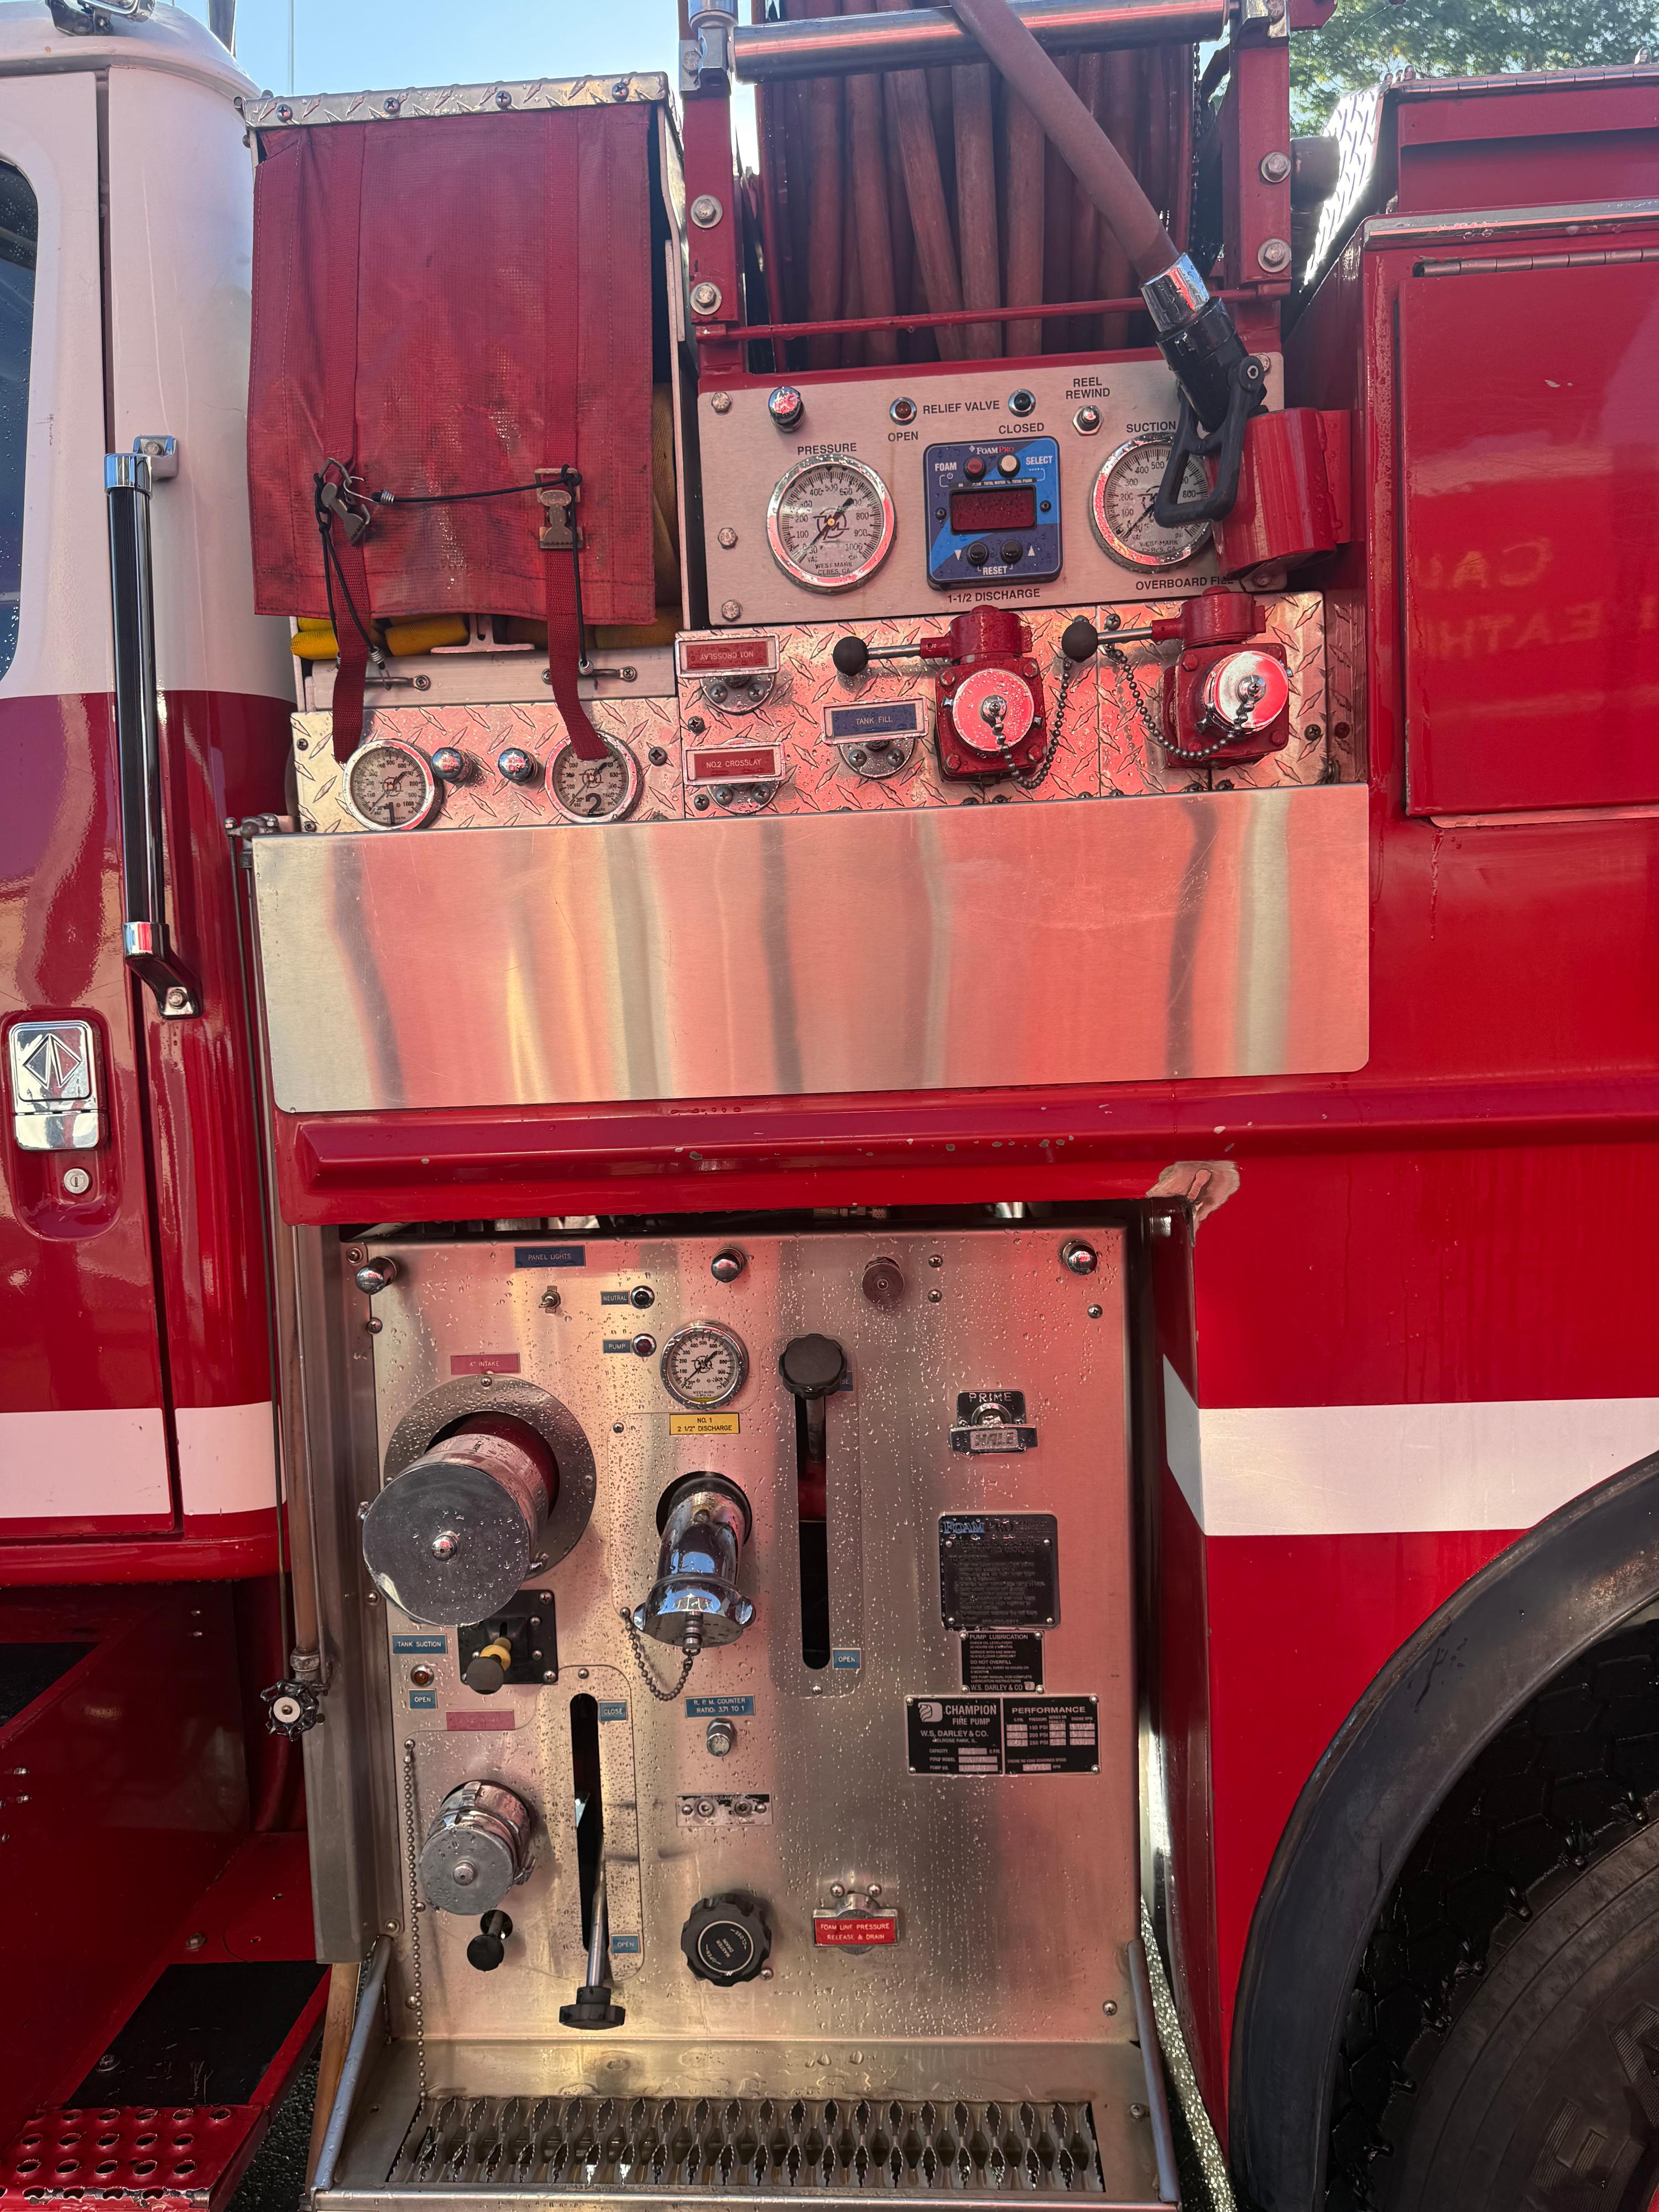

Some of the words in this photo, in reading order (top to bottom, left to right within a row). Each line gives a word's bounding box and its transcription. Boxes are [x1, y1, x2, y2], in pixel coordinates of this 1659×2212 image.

[1073, 377, 1102, 388] REEL
[1066, 388, 1110, 399] REWIND
[923, 403, 962, 414] RELIEF
[964, 400, 1000, 411] VALVE
[999, 422, 1045, 434] CLOSED
[1126, 421, 1176, 433] SUCTION
[888, 431, 919, 441] OPEN
[797, 442, 857, 455] PRESSURE
[1026, 455, 1053, 466] SELECT
[1151, 461, 1165, 469] 500
[935, 462, 957, 472] FOAM
[1121, 509, 1134, 517] 100
[983, 566, 1008, 575] RESET
[1136, 577, 1207, 590] OVERBOARD
[948, 593, 972, 603] 1-1/2
[975, 588, 1040, 601] DISCHARGE
[700, 652, 737, 660] CROSSLAY
[725, 759, 761, 767] CROSSLAY
[586, 793, 603, 818] 2
[384, 802, 395, 825] 1
[969, 1392, 1012, 1402] PRIME
[975, 1432, 1014, 1447] HALE
[945, 1705, 997, 1715] CHAMPION
[716, 1939, 731, 1958] MASTER
[722, 1939, 734, 1953] DRAIN
[705, 1950, 717, 1963] OPEN
